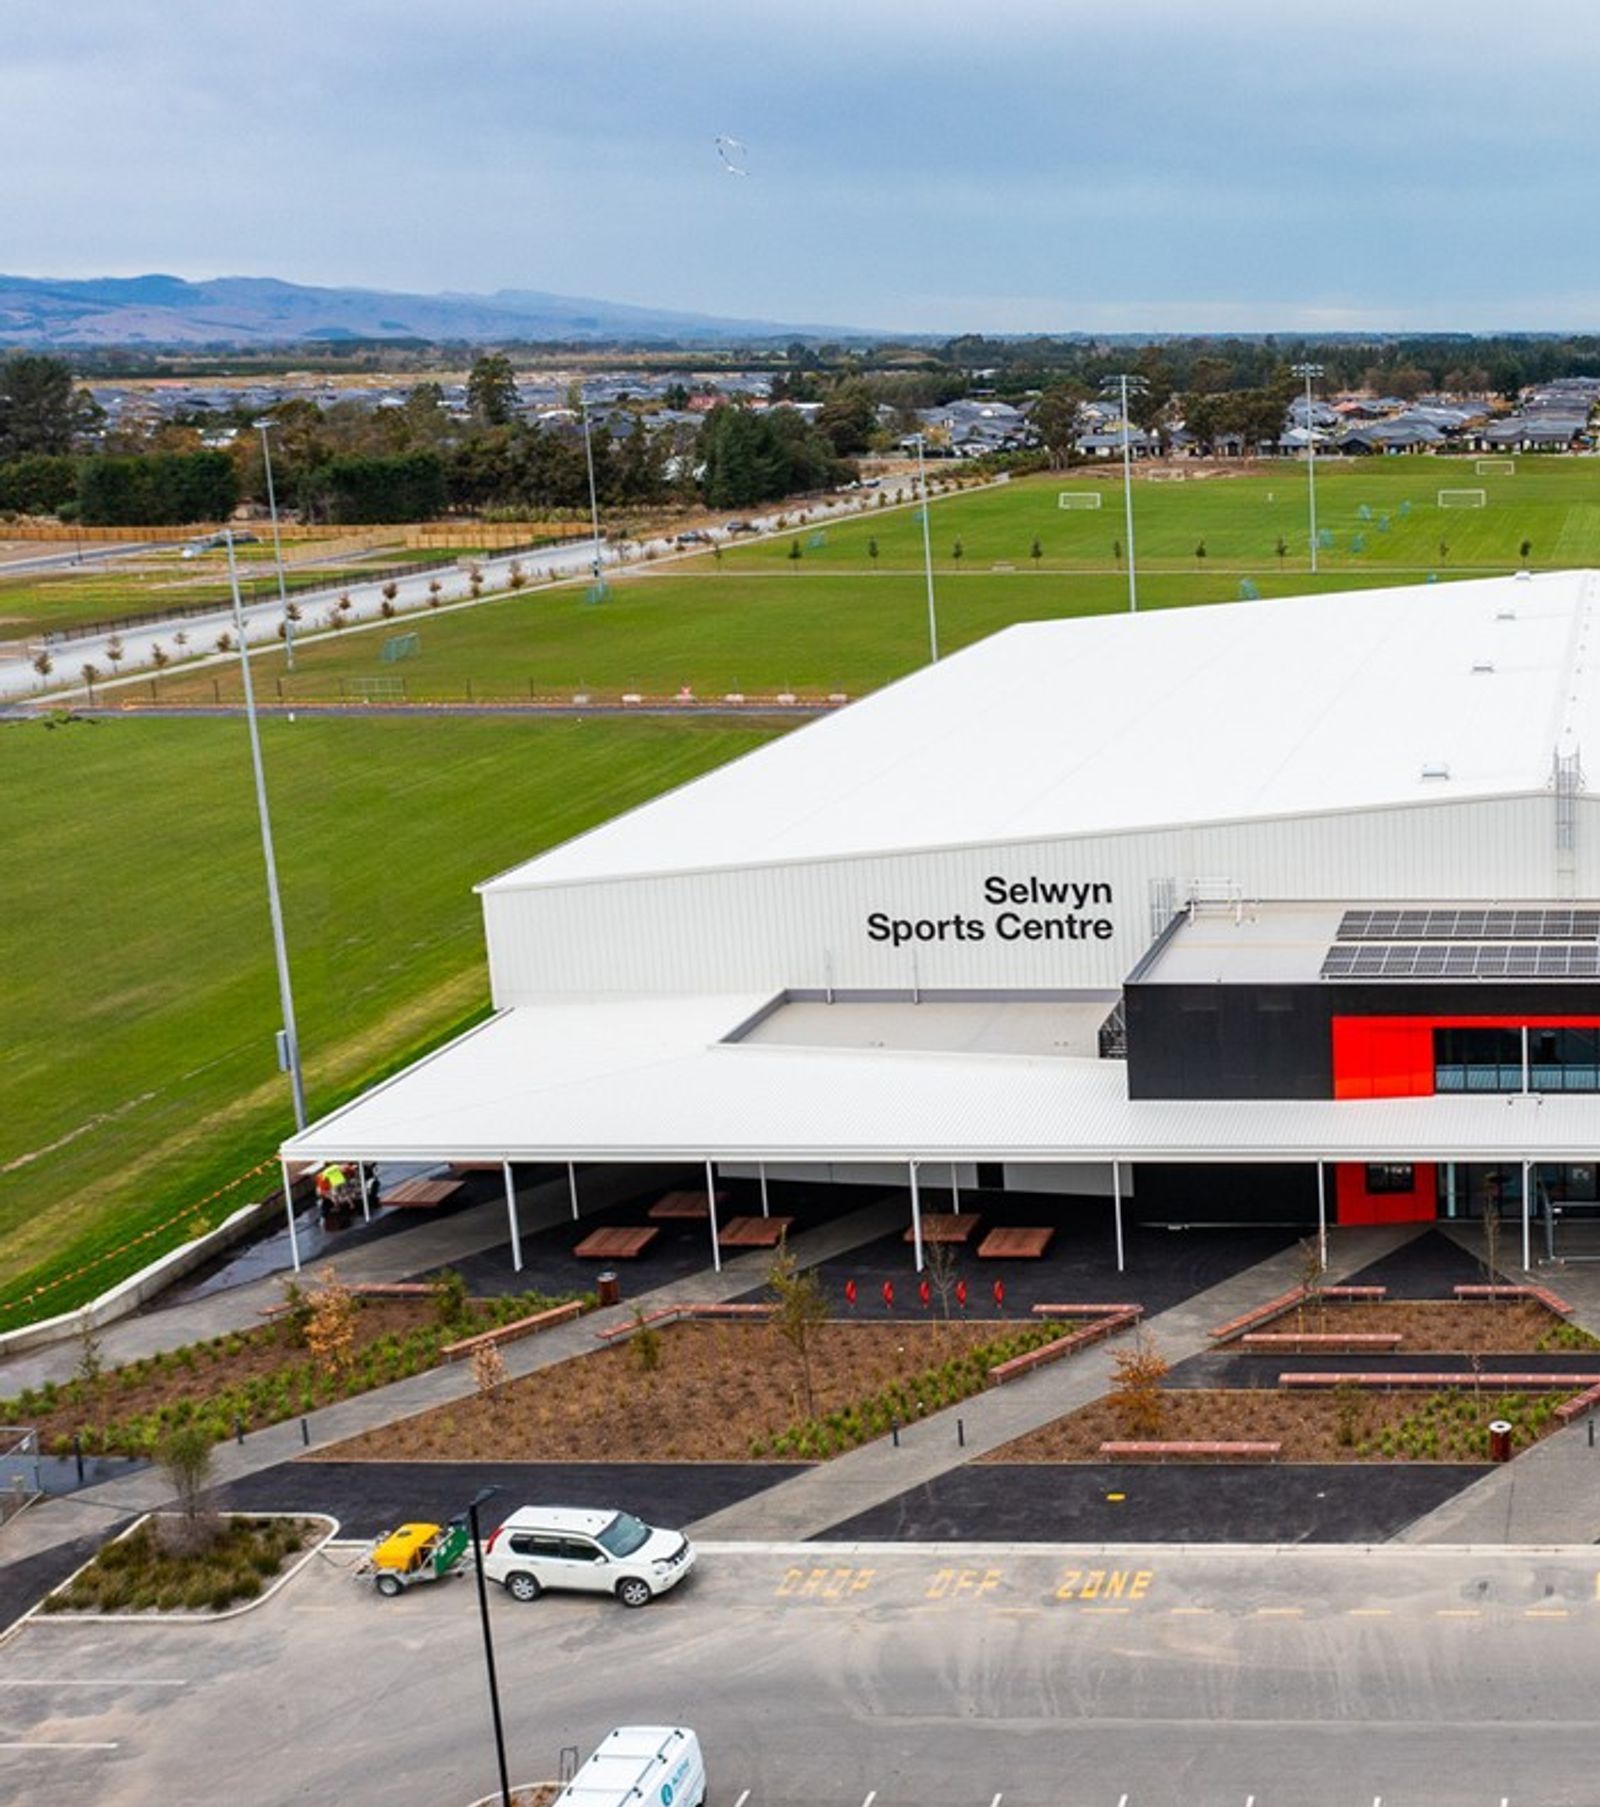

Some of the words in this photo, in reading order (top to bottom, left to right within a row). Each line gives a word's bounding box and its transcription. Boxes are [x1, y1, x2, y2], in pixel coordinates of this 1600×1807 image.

[984, 876, 1113, 910] Selwyn
[867, 912, 986, 947] Sports
[995, 911, 1114, 941] Centre
[774, 1567, 877, 1597] DROP
[924, 1568, 1002, 1599] OFF
[1055, 1569, 1154, 1600] ZONE
